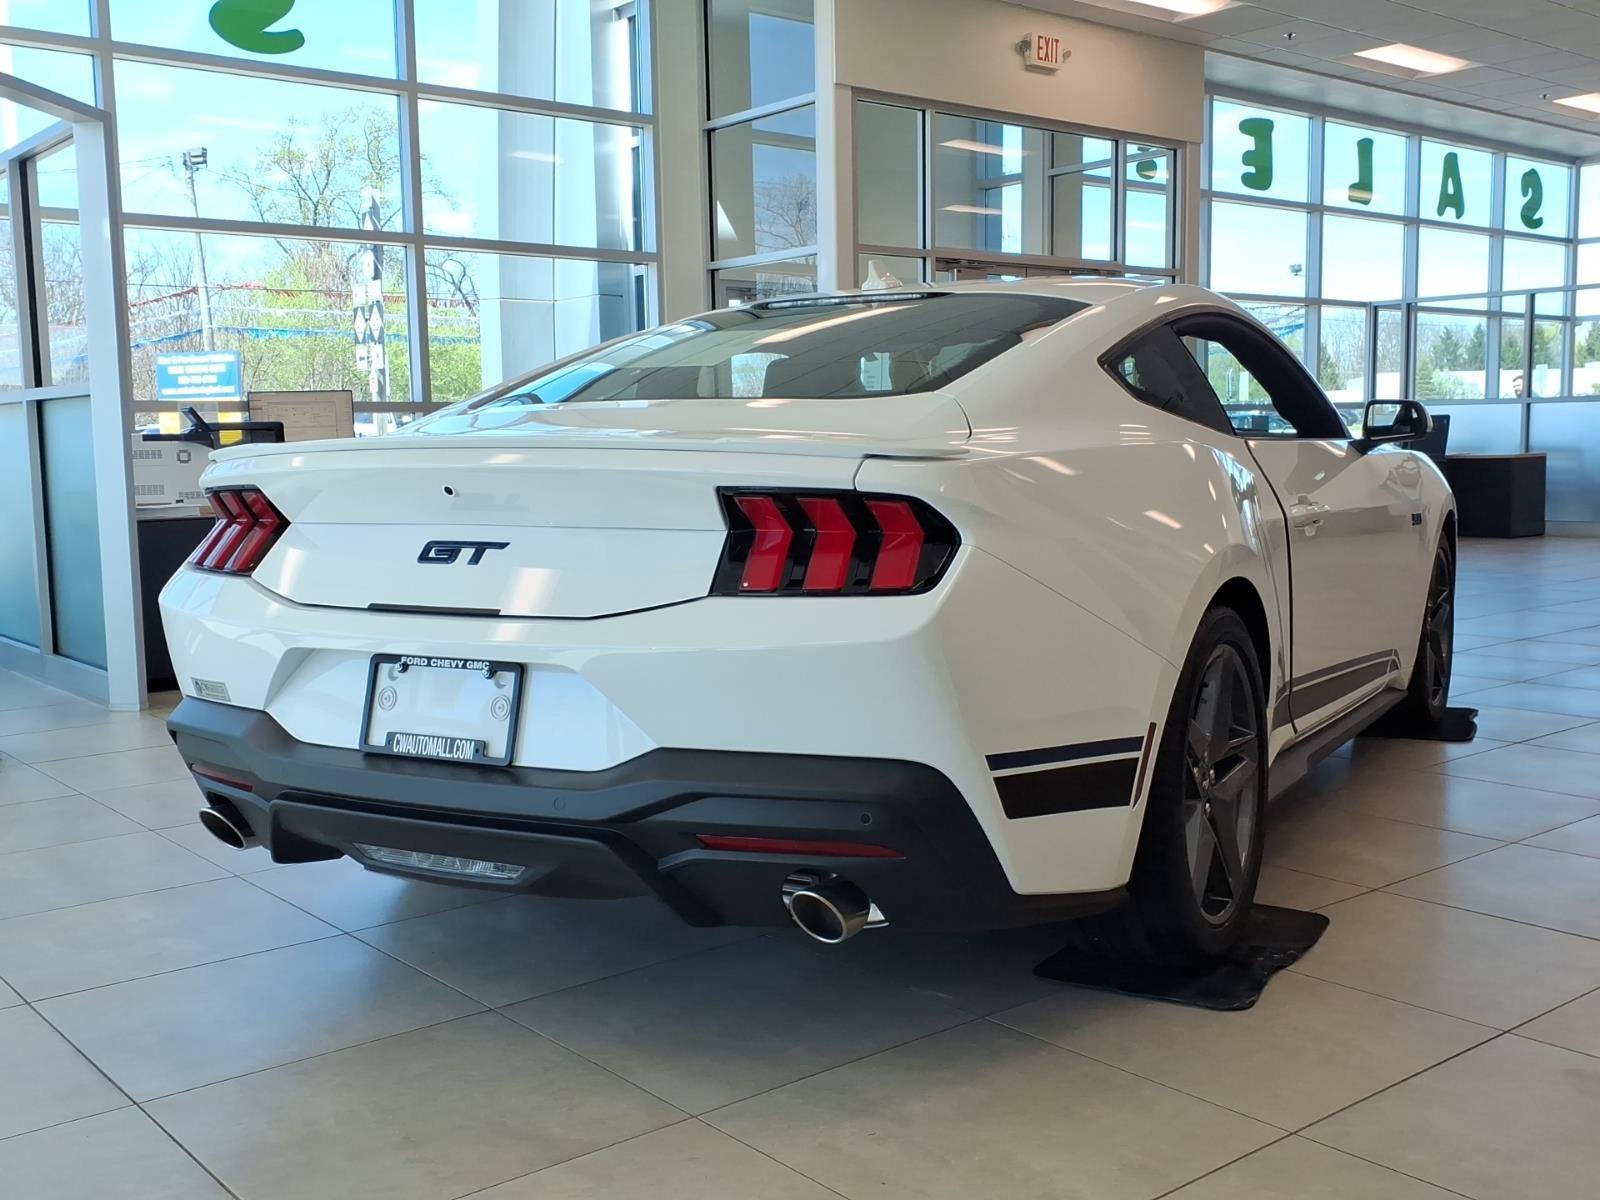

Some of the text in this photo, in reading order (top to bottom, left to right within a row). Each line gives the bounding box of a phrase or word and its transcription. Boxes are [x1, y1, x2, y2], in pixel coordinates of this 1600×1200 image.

[1037, 35, 1060, 64] EXIT
[417, 540, 511, 565] GT
[401, 656, 490, 670] FORD CHEVY GMC
[393, 733, 475, 760] CWAUTOMALL.COM
